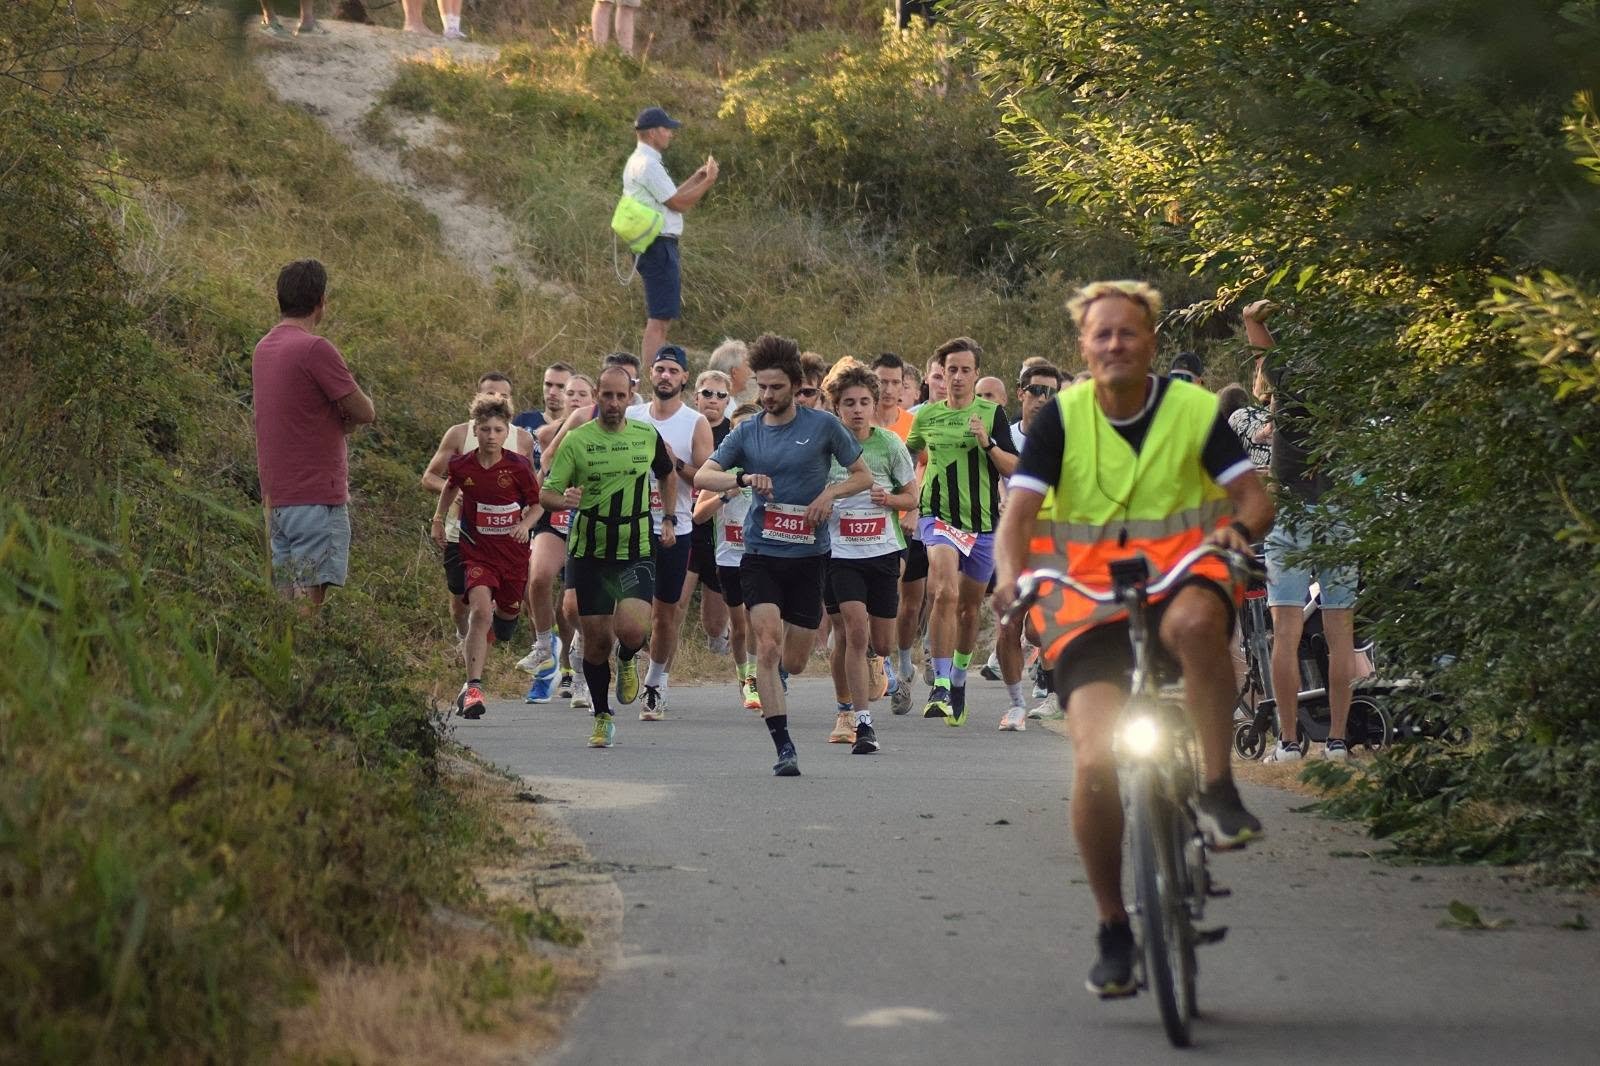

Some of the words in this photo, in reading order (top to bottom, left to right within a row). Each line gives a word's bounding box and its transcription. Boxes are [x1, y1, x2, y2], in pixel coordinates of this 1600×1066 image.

[486, 515, 513, 526] 1354
[774, 516, 804, 531] 2481
[848, 522, 877, 534] 1377
[768, 531, 809, 541] ZOMERLOPEN
